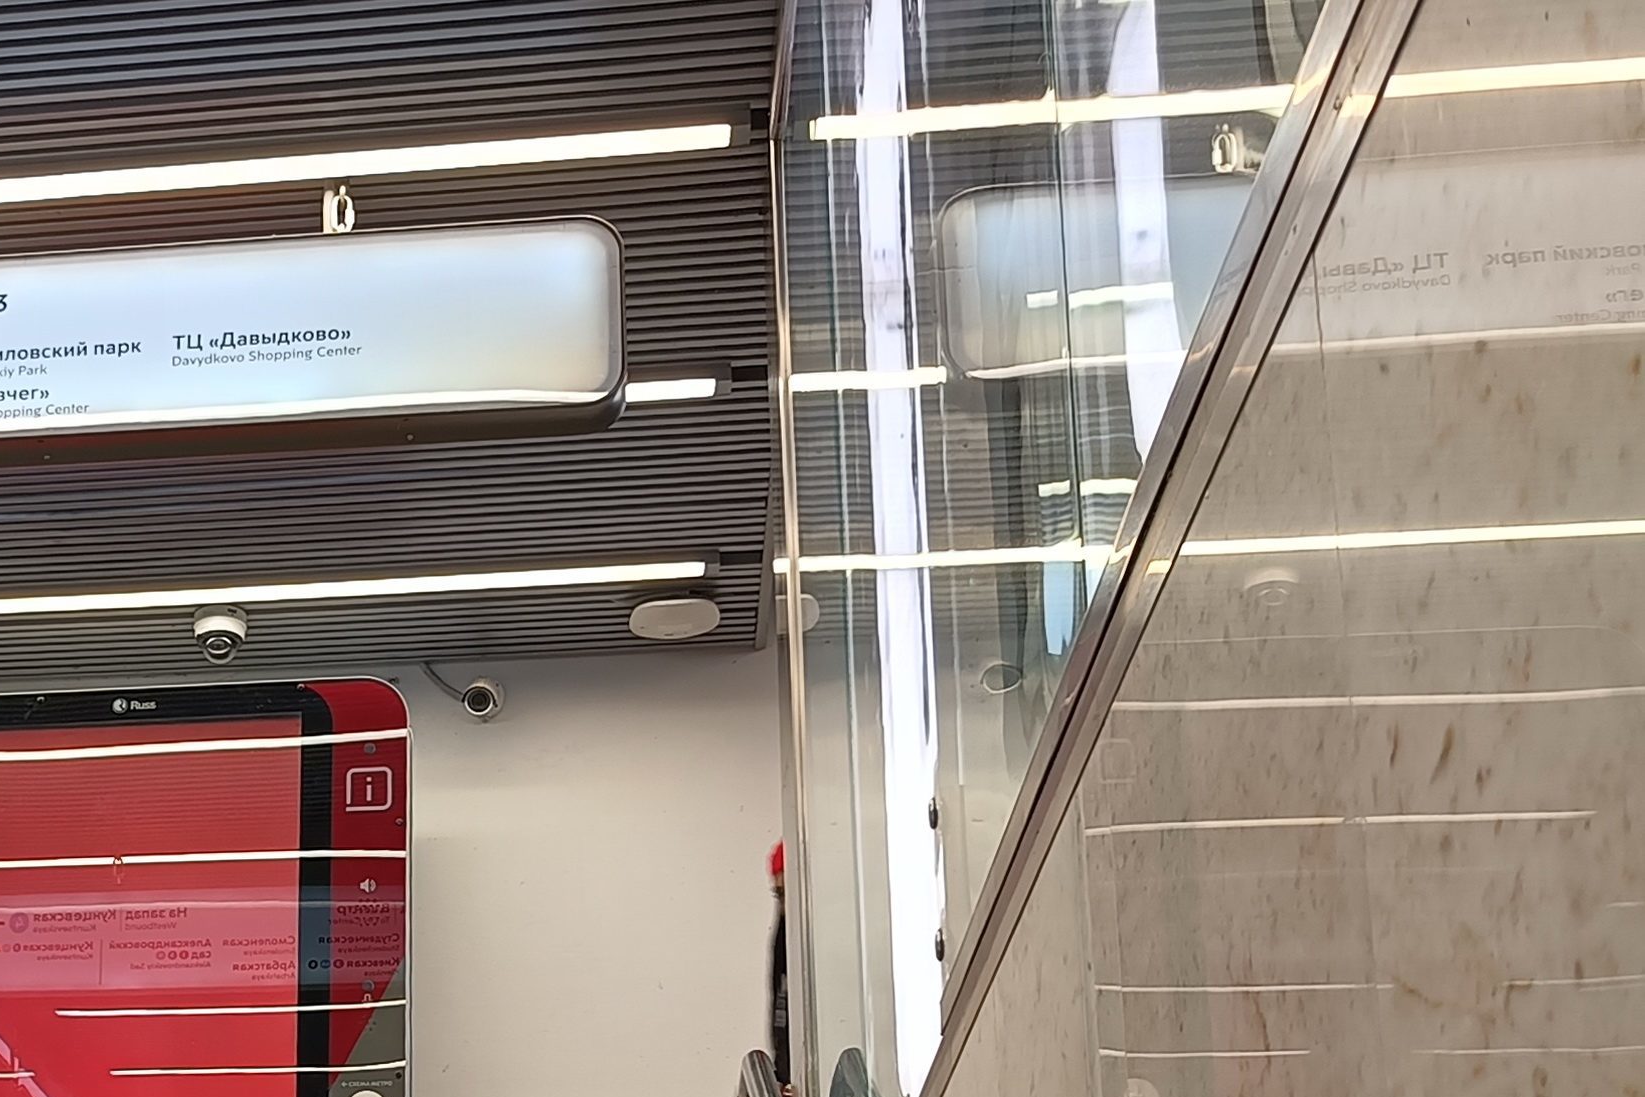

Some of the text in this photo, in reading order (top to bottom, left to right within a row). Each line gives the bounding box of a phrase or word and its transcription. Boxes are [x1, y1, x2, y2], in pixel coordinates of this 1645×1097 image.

[173, 327, 351, 352] ТЦ «Давыдково»
[93, 339, 142, 357] парк
[171, 343, 362, 368] Davydkovo Shopping Center
[17, 364, 47, 377] Park
[45, 403, 89, 415] Center
[130, 701, 157, 710] Russ
